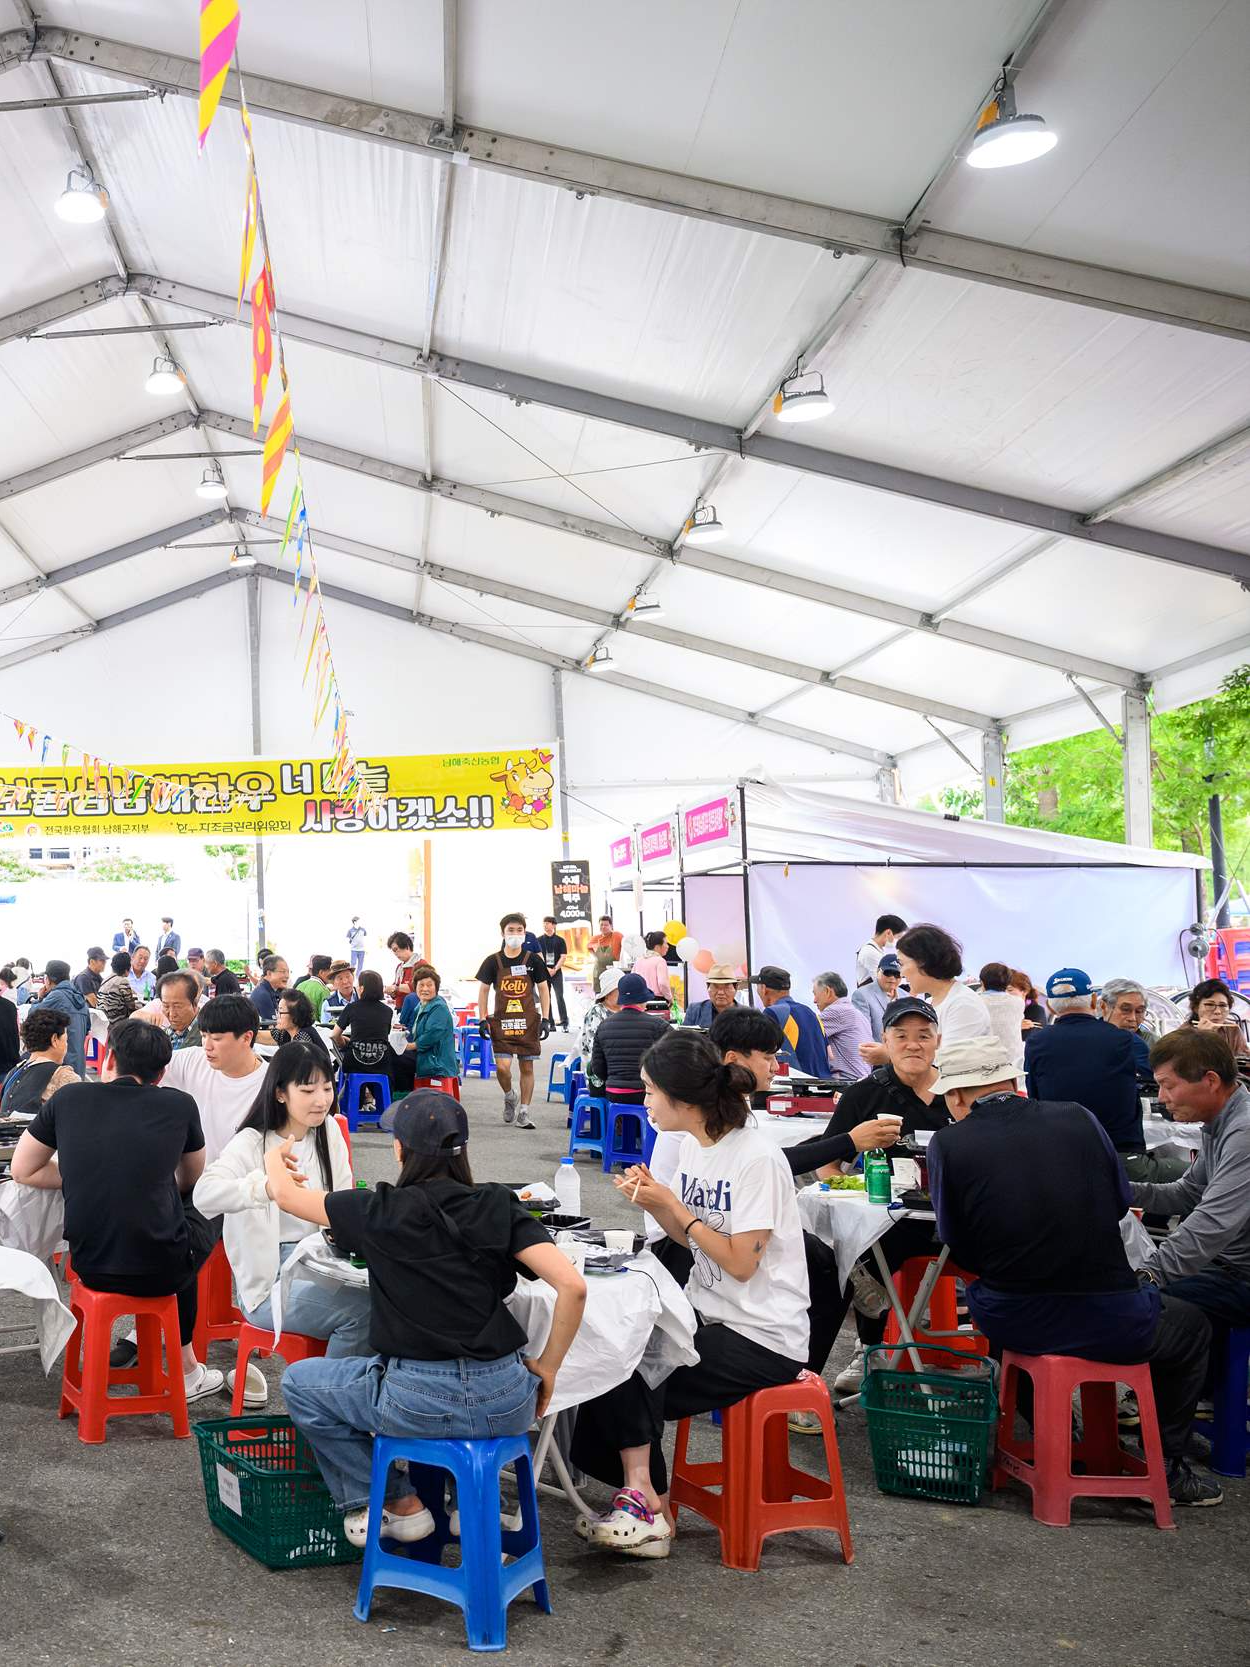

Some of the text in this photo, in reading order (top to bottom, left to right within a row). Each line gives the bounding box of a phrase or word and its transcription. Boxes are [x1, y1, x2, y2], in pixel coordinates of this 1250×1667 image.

[280, 762, 313, 795] 너
[299, 794, 494, 834] 사랑하겠소!!
[500, 979, 528, 995] Kelly
